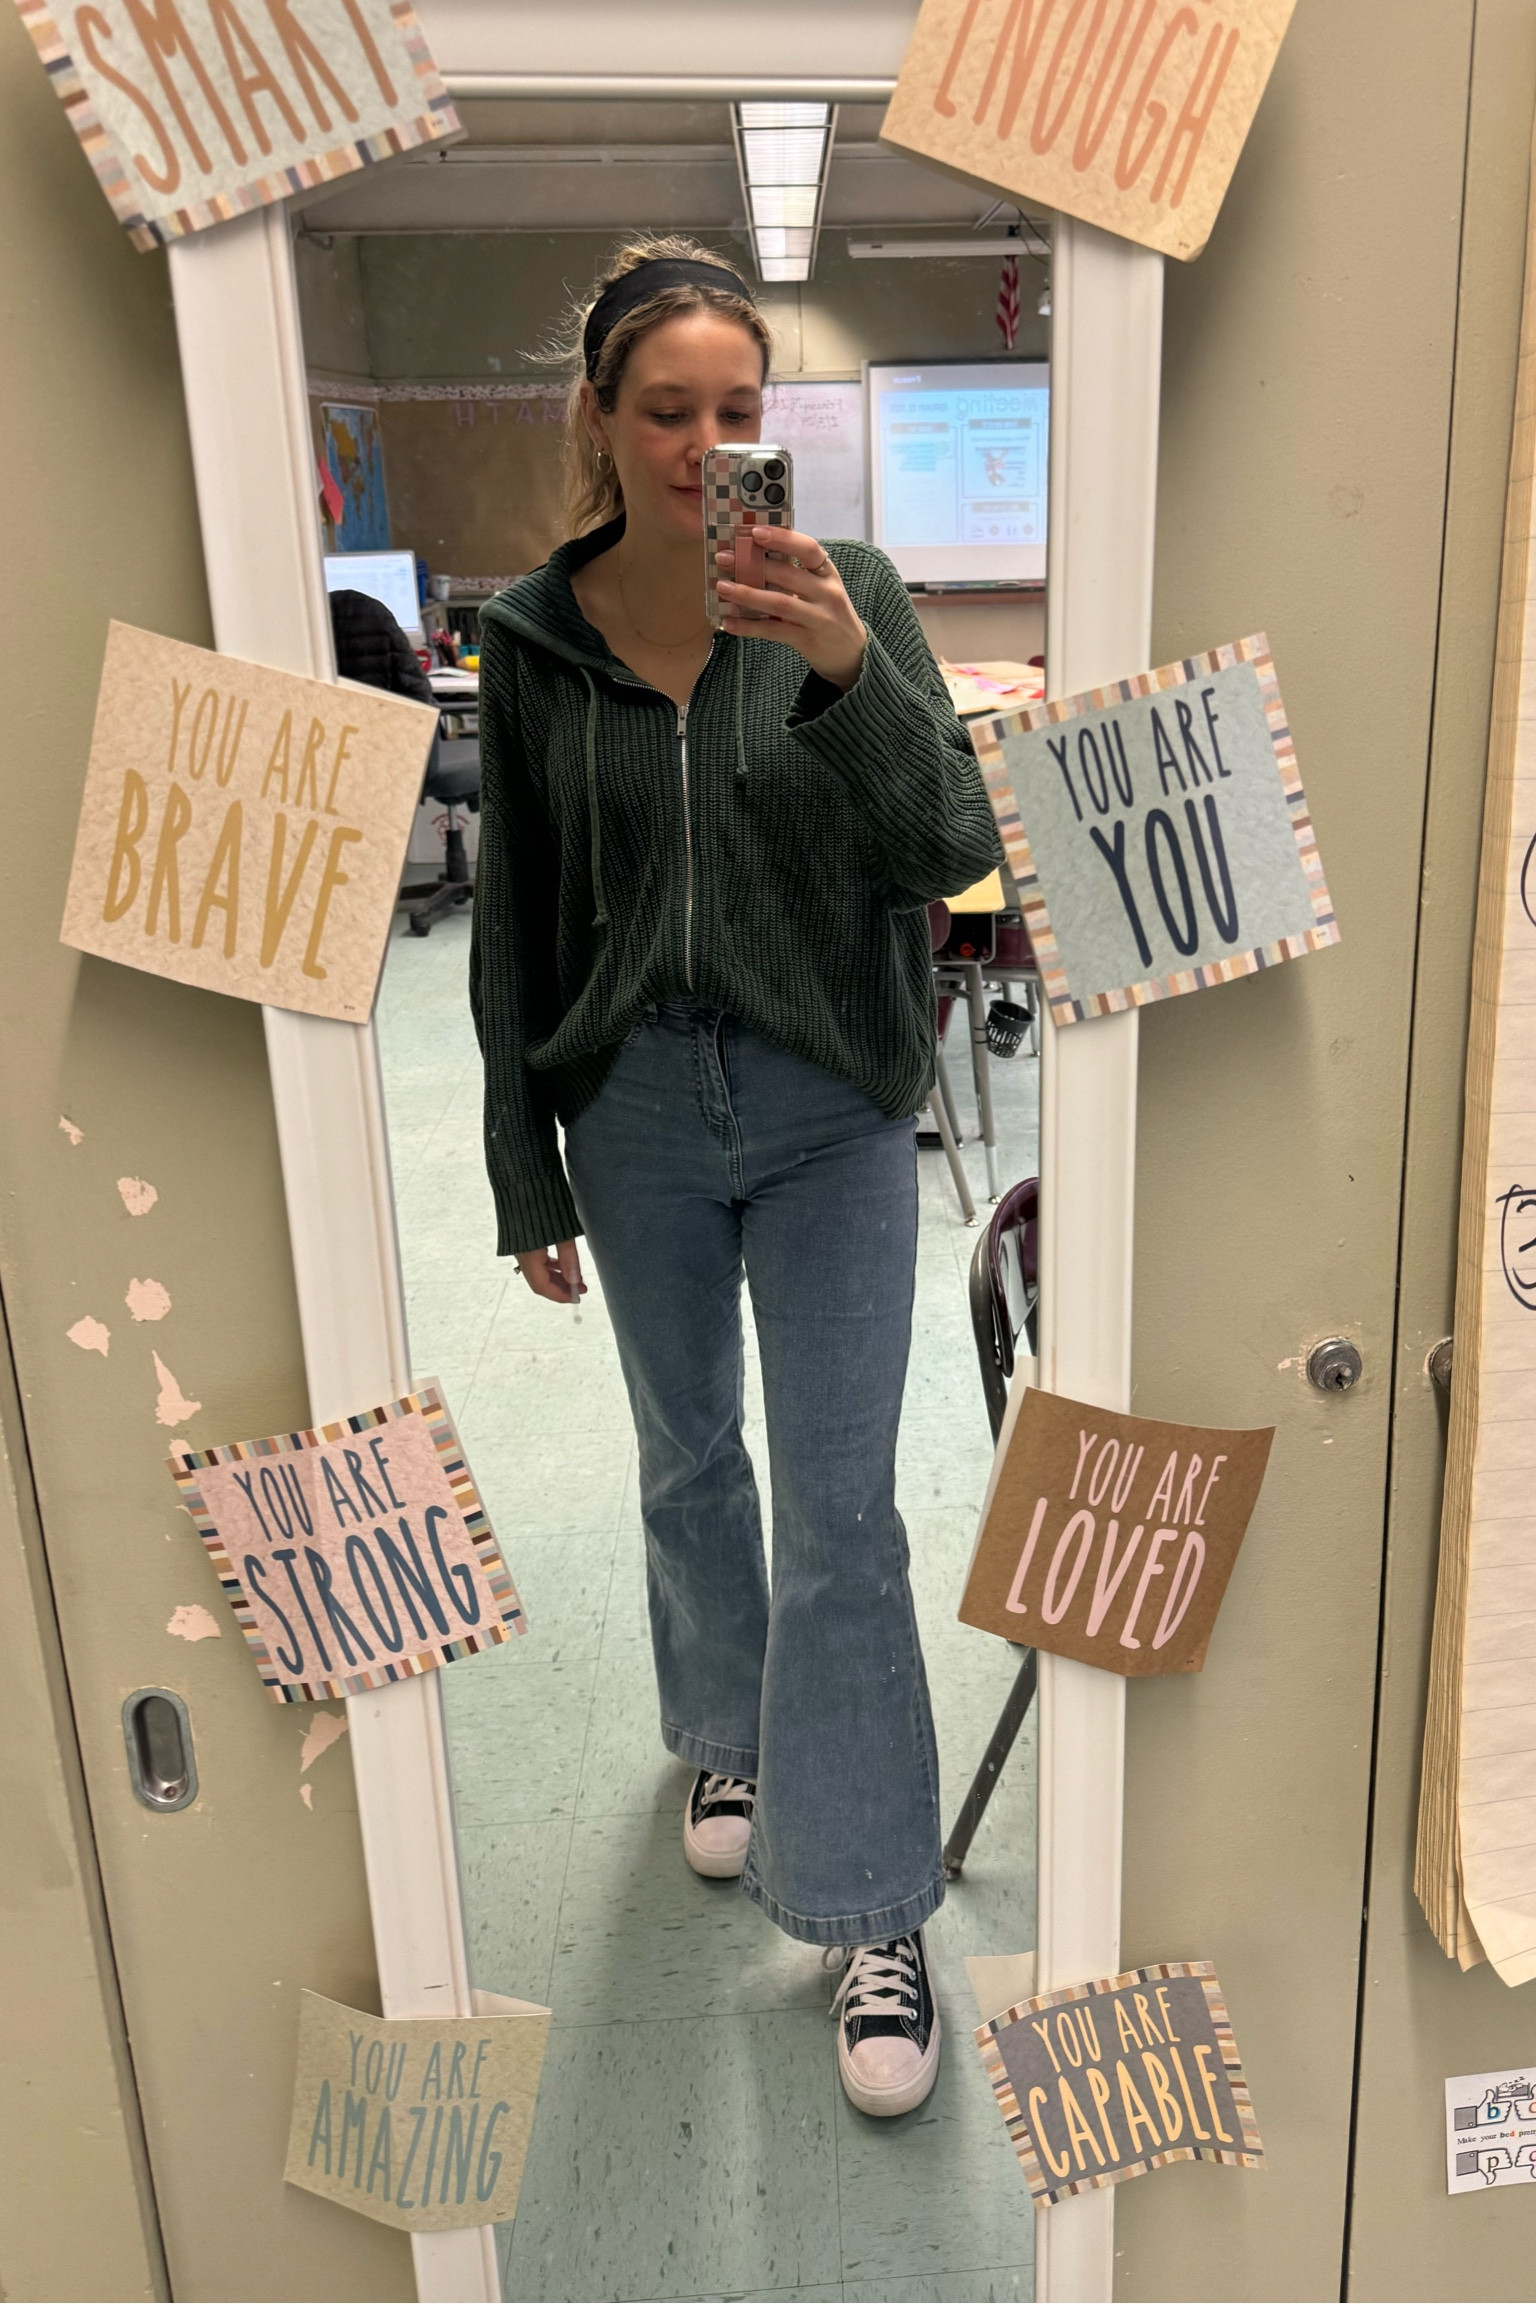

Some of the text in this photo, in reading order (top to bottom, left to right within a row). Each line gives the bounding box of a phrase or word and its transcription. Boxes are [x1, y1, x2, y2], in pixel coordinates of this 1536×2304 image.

[167, 677, 360, 815] YOU ARE
[1046, 687, 1232, 822] YOU ARE
[102, 768, 363, 980] BRAVE
[1089, 794, 1240, 968] YOU
[232, 1436, 407, 1543] YOU ARE
[1068, 1429, 1228, 1525] YOU ARE
[243, 1505, 481, 1675] STRONG
[1005, 1497, 1206, 1650] LOVED
[348, 2029, 492, 2102] YOU ARE
[1031, 1986, 1181, 2073] YOU ARE
[307, 2078, 511, 2209] AMAZING
[1028, 2044, 1234, 2178] CAPABLE
[1457, 2136, 1477, 2145] Make
[1480, 2133, 1497, 2143] your
[1500, 2130, 1515, 2139] bed
[1486, 2102, 1501, 2120] b
[1486, 2156, 1500, 2173] p
